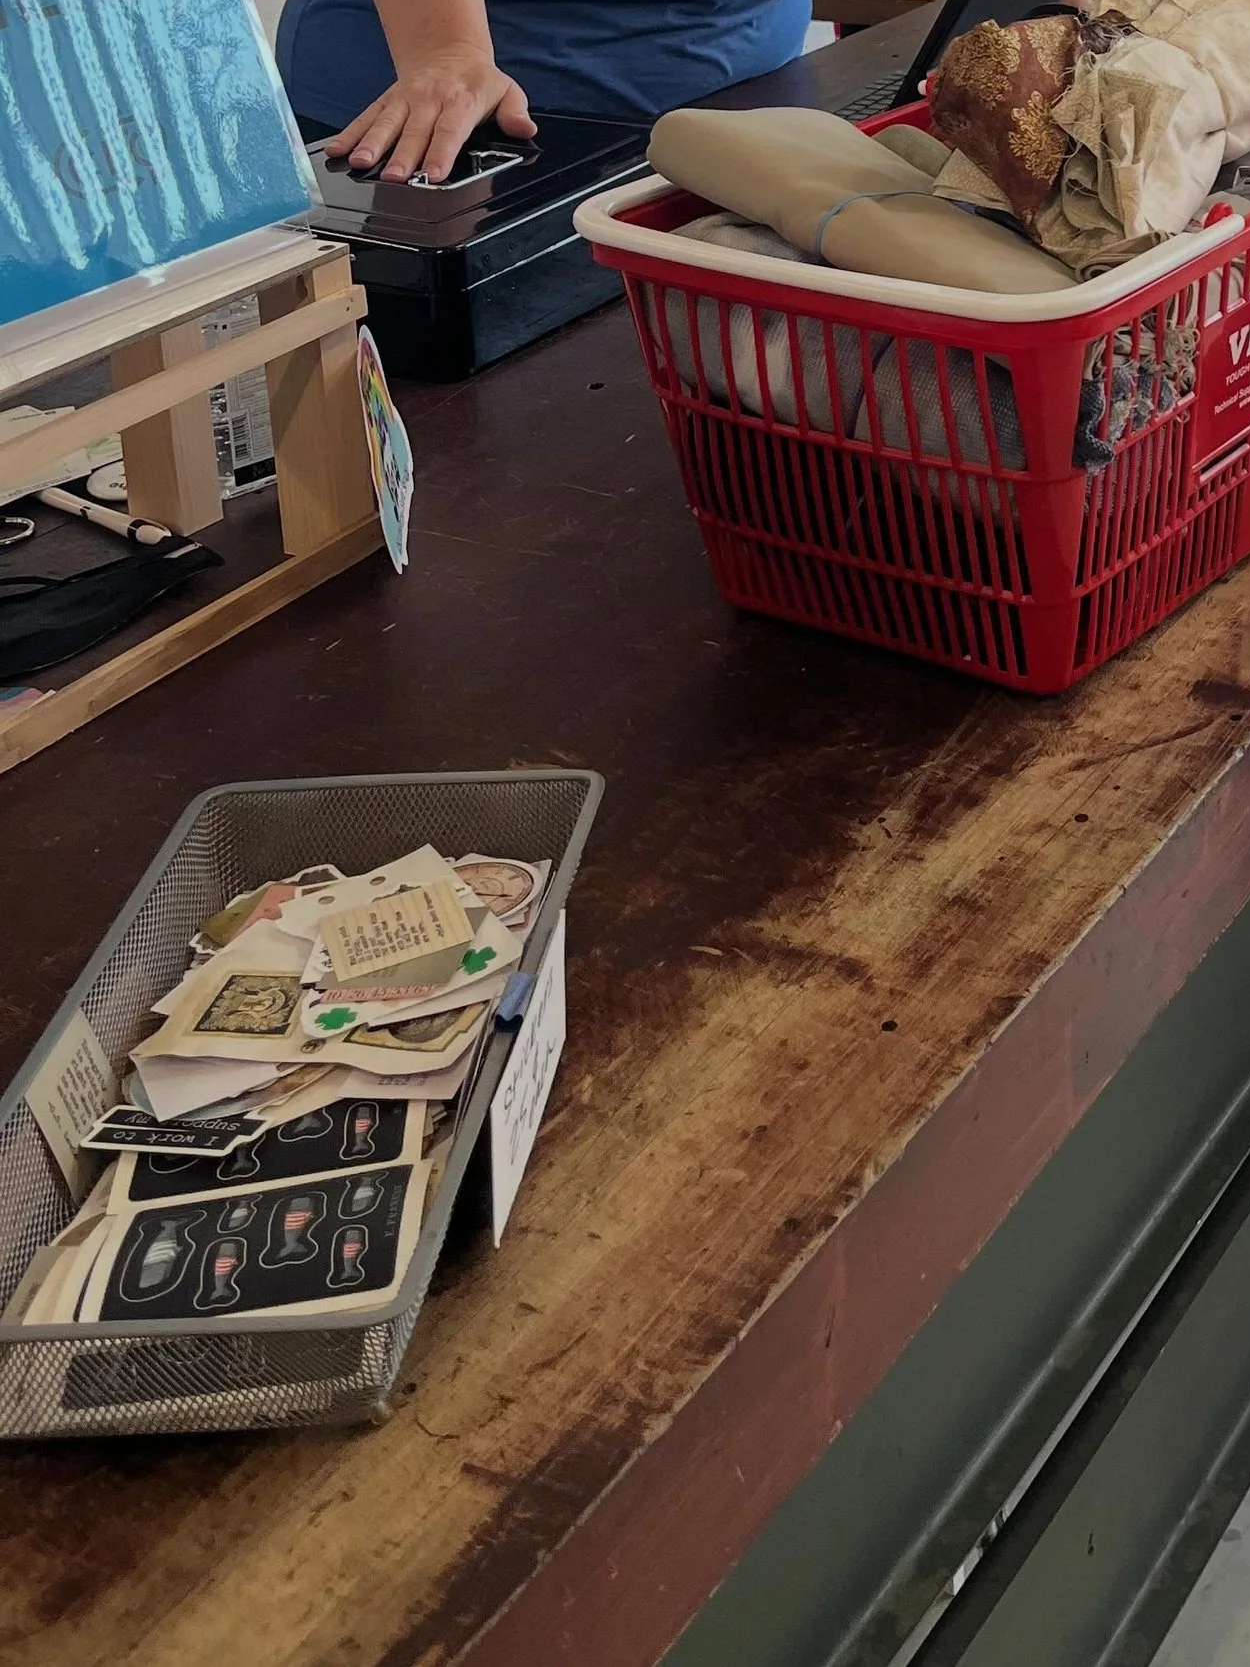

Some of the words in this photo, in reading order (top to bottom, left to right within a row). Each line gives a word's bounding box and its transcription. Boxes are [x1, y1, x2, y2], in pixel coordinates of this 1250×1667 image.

[1226, 362, 1250, 386] TOUGH
[112, 1131, 137, 1142] to
[146, 1133, 196, 1145] work
